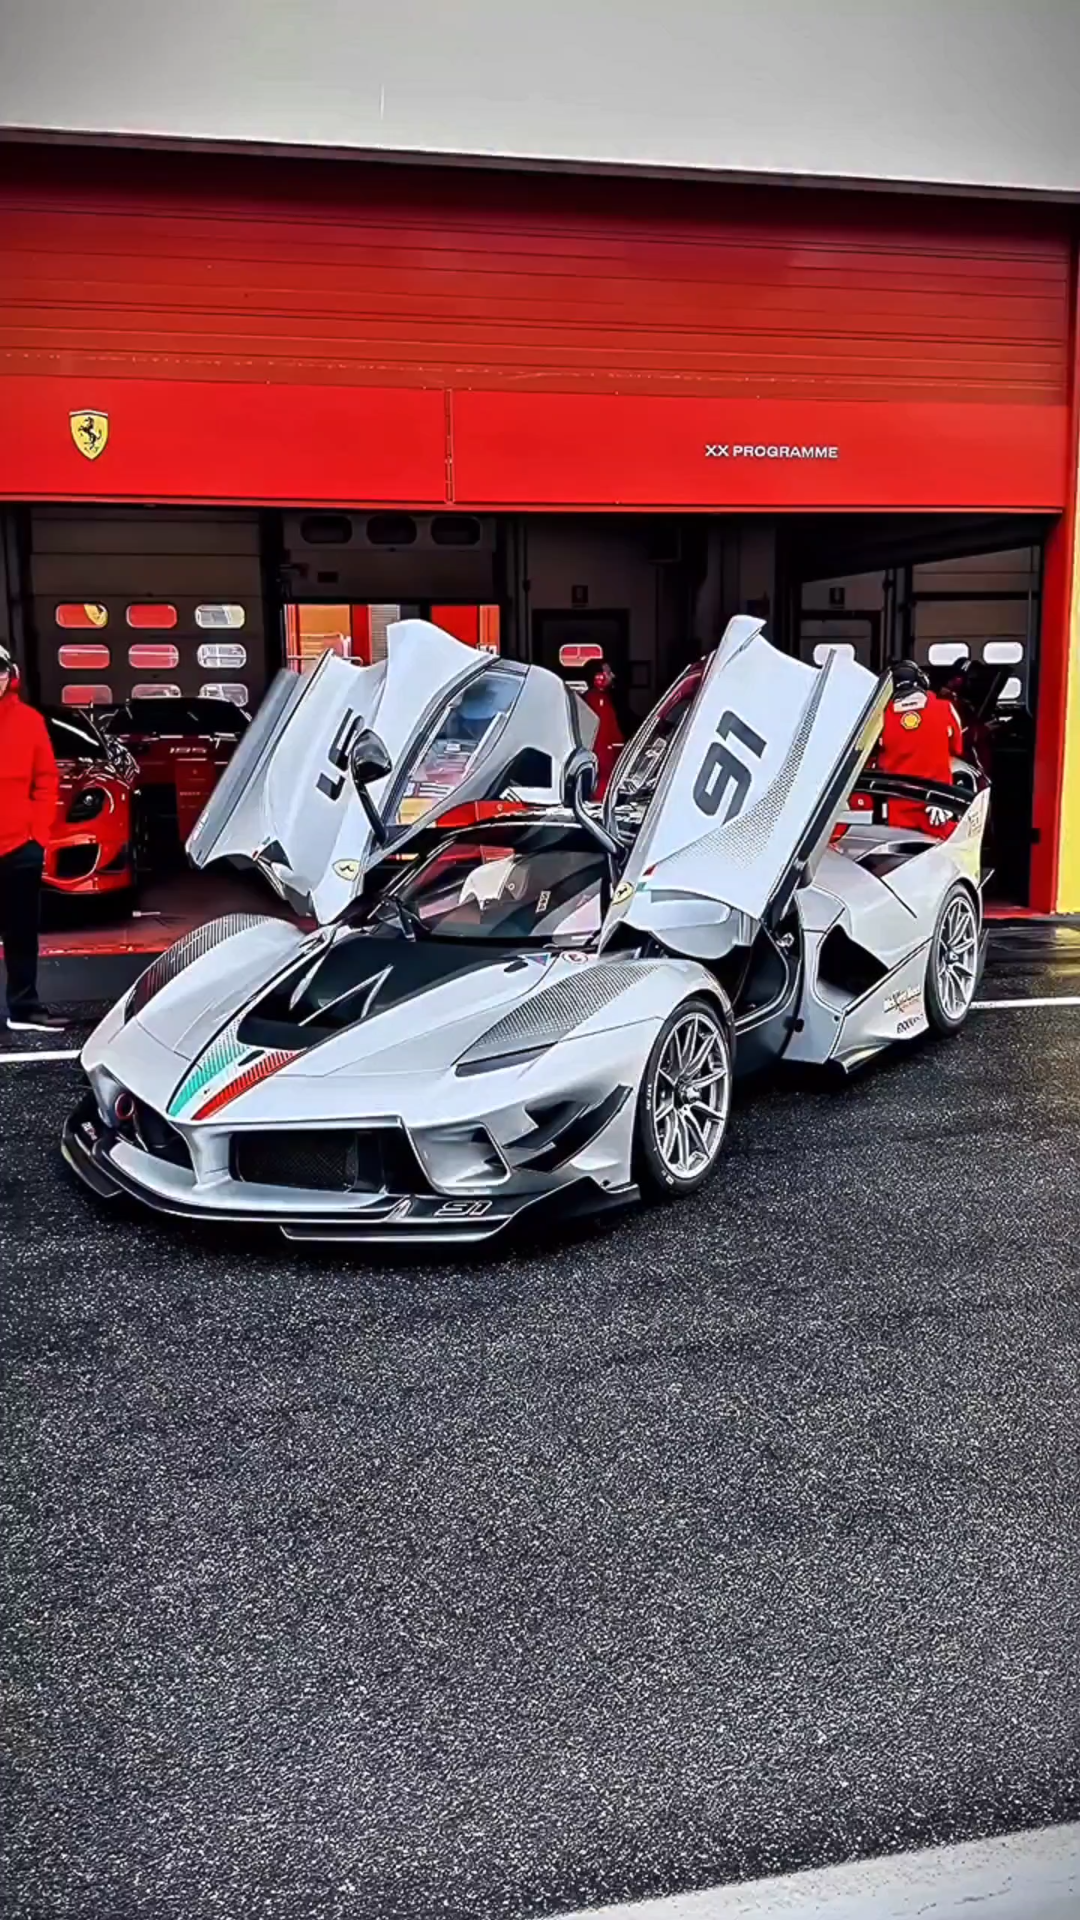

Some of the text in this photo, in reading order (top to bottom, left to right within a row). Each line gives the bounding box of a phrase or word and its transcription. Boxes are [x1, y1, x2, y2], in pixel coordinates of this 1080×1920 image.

[705, 445, 838, 459] XX PROGRAMME
[693, 710, 767, 827] 91
[433, 1199, 493, 1217] 91
